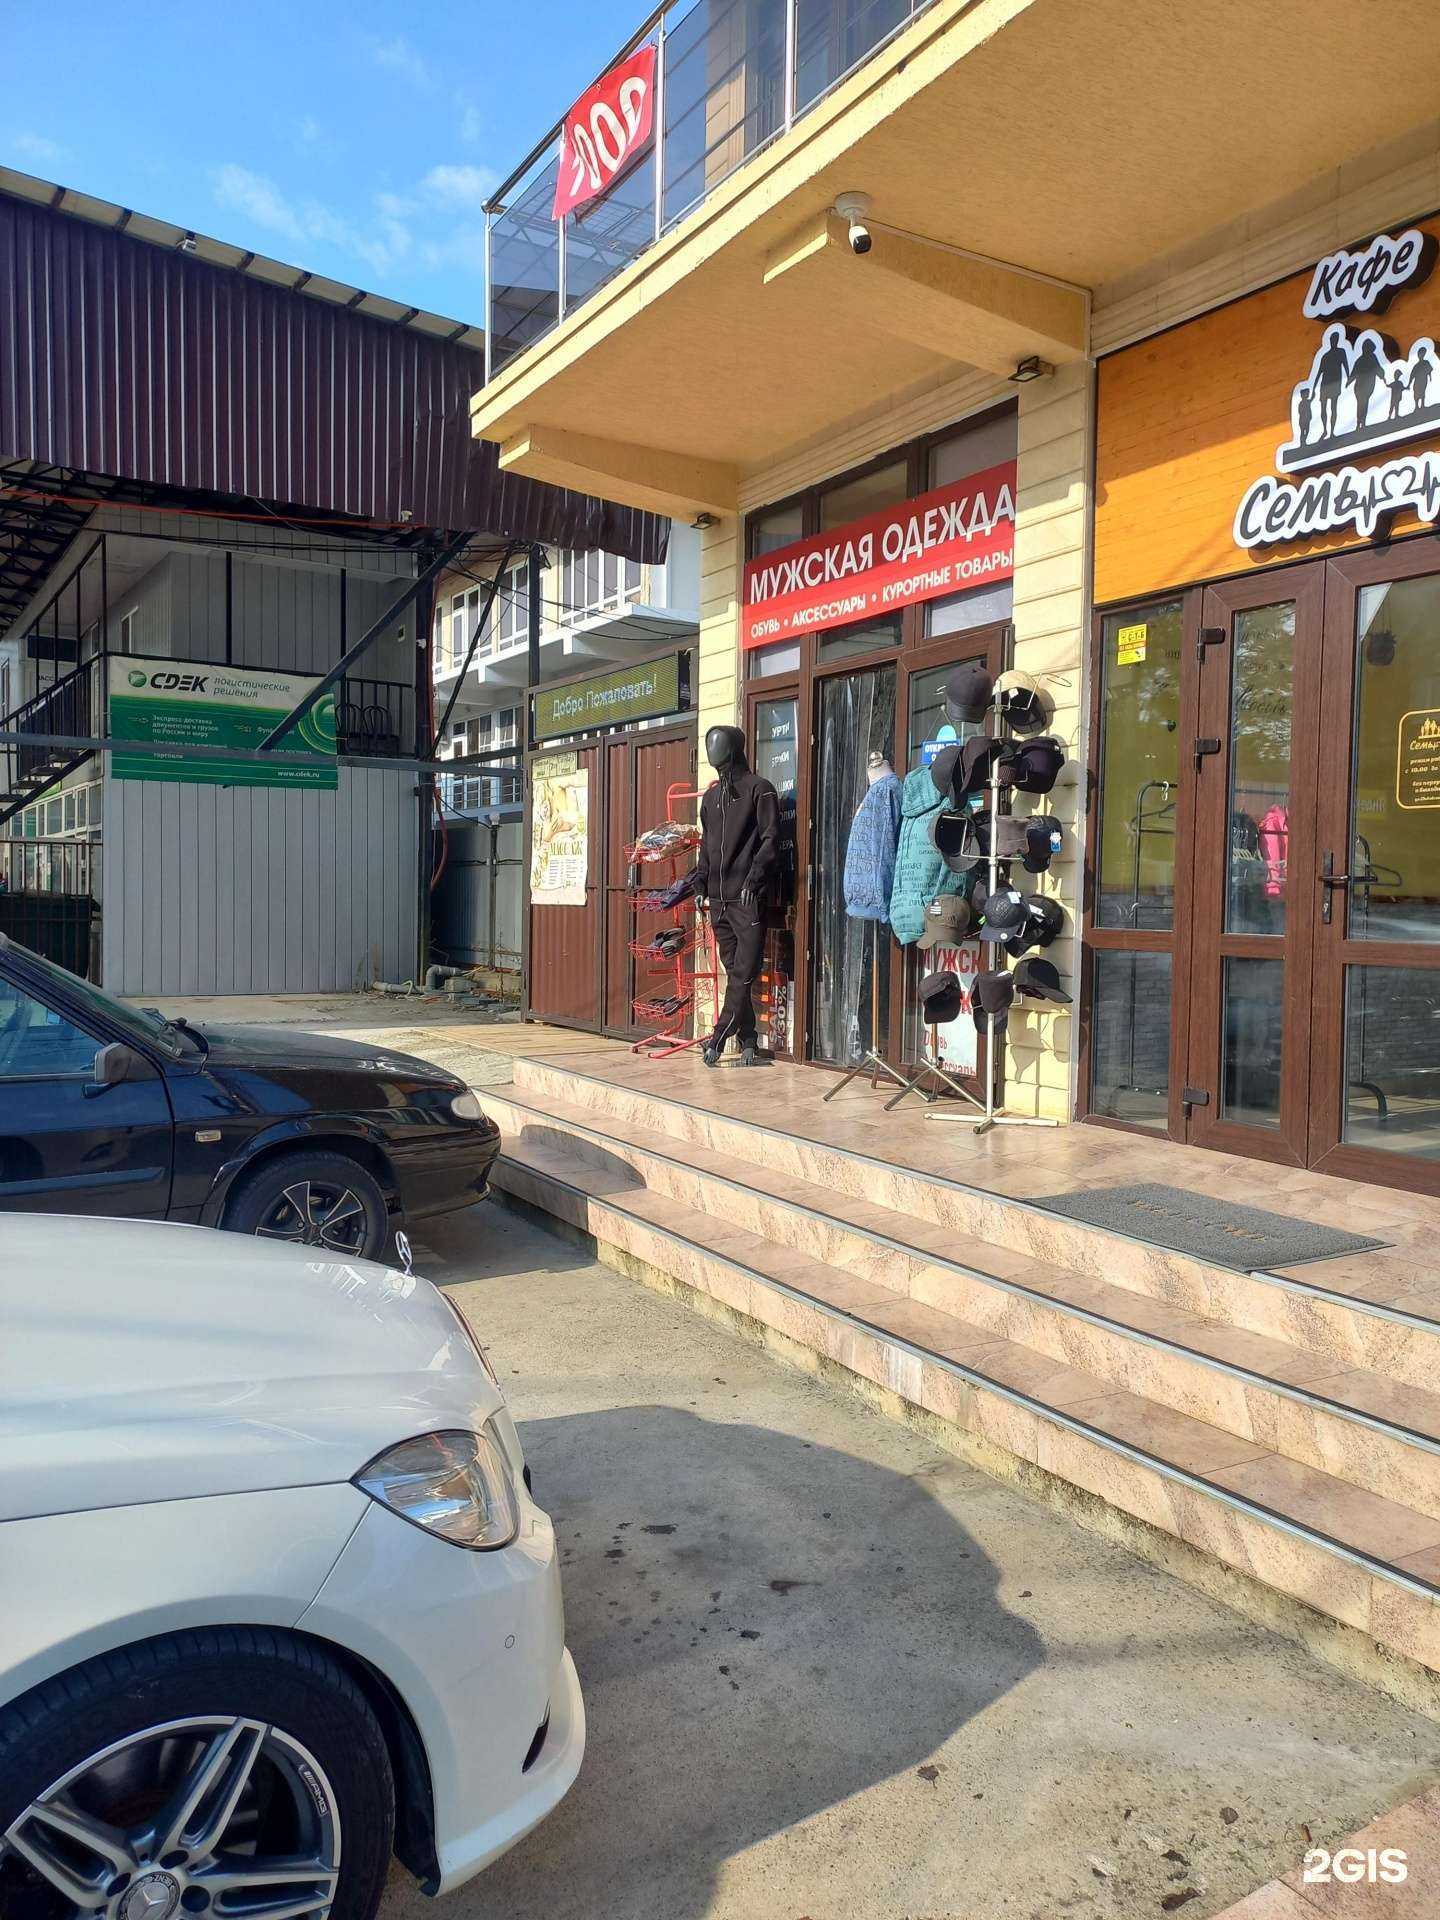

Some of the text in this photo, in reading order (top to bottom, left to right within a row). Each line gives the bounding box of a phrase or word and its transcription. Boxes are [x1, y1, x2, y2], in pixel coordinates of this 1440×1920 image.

[1310, 240, 1415, 307] Кафе
[750, 484, 1016, 605] МУЖСКАЯ ОДЕЖДА
[751, 548, 1013, 639] ОБУВЬ АКСЕССУАРЫ КУРОРТНЫЕ ТОВАРЫ
[150, 672, 210, 693] CDEK
[213, 686, 258, 698] решения
[214, 677, 291, 693] логистические
[552, 696, 584, 722] Добро
[277, 770, 320, 778] www.cdek.ru
